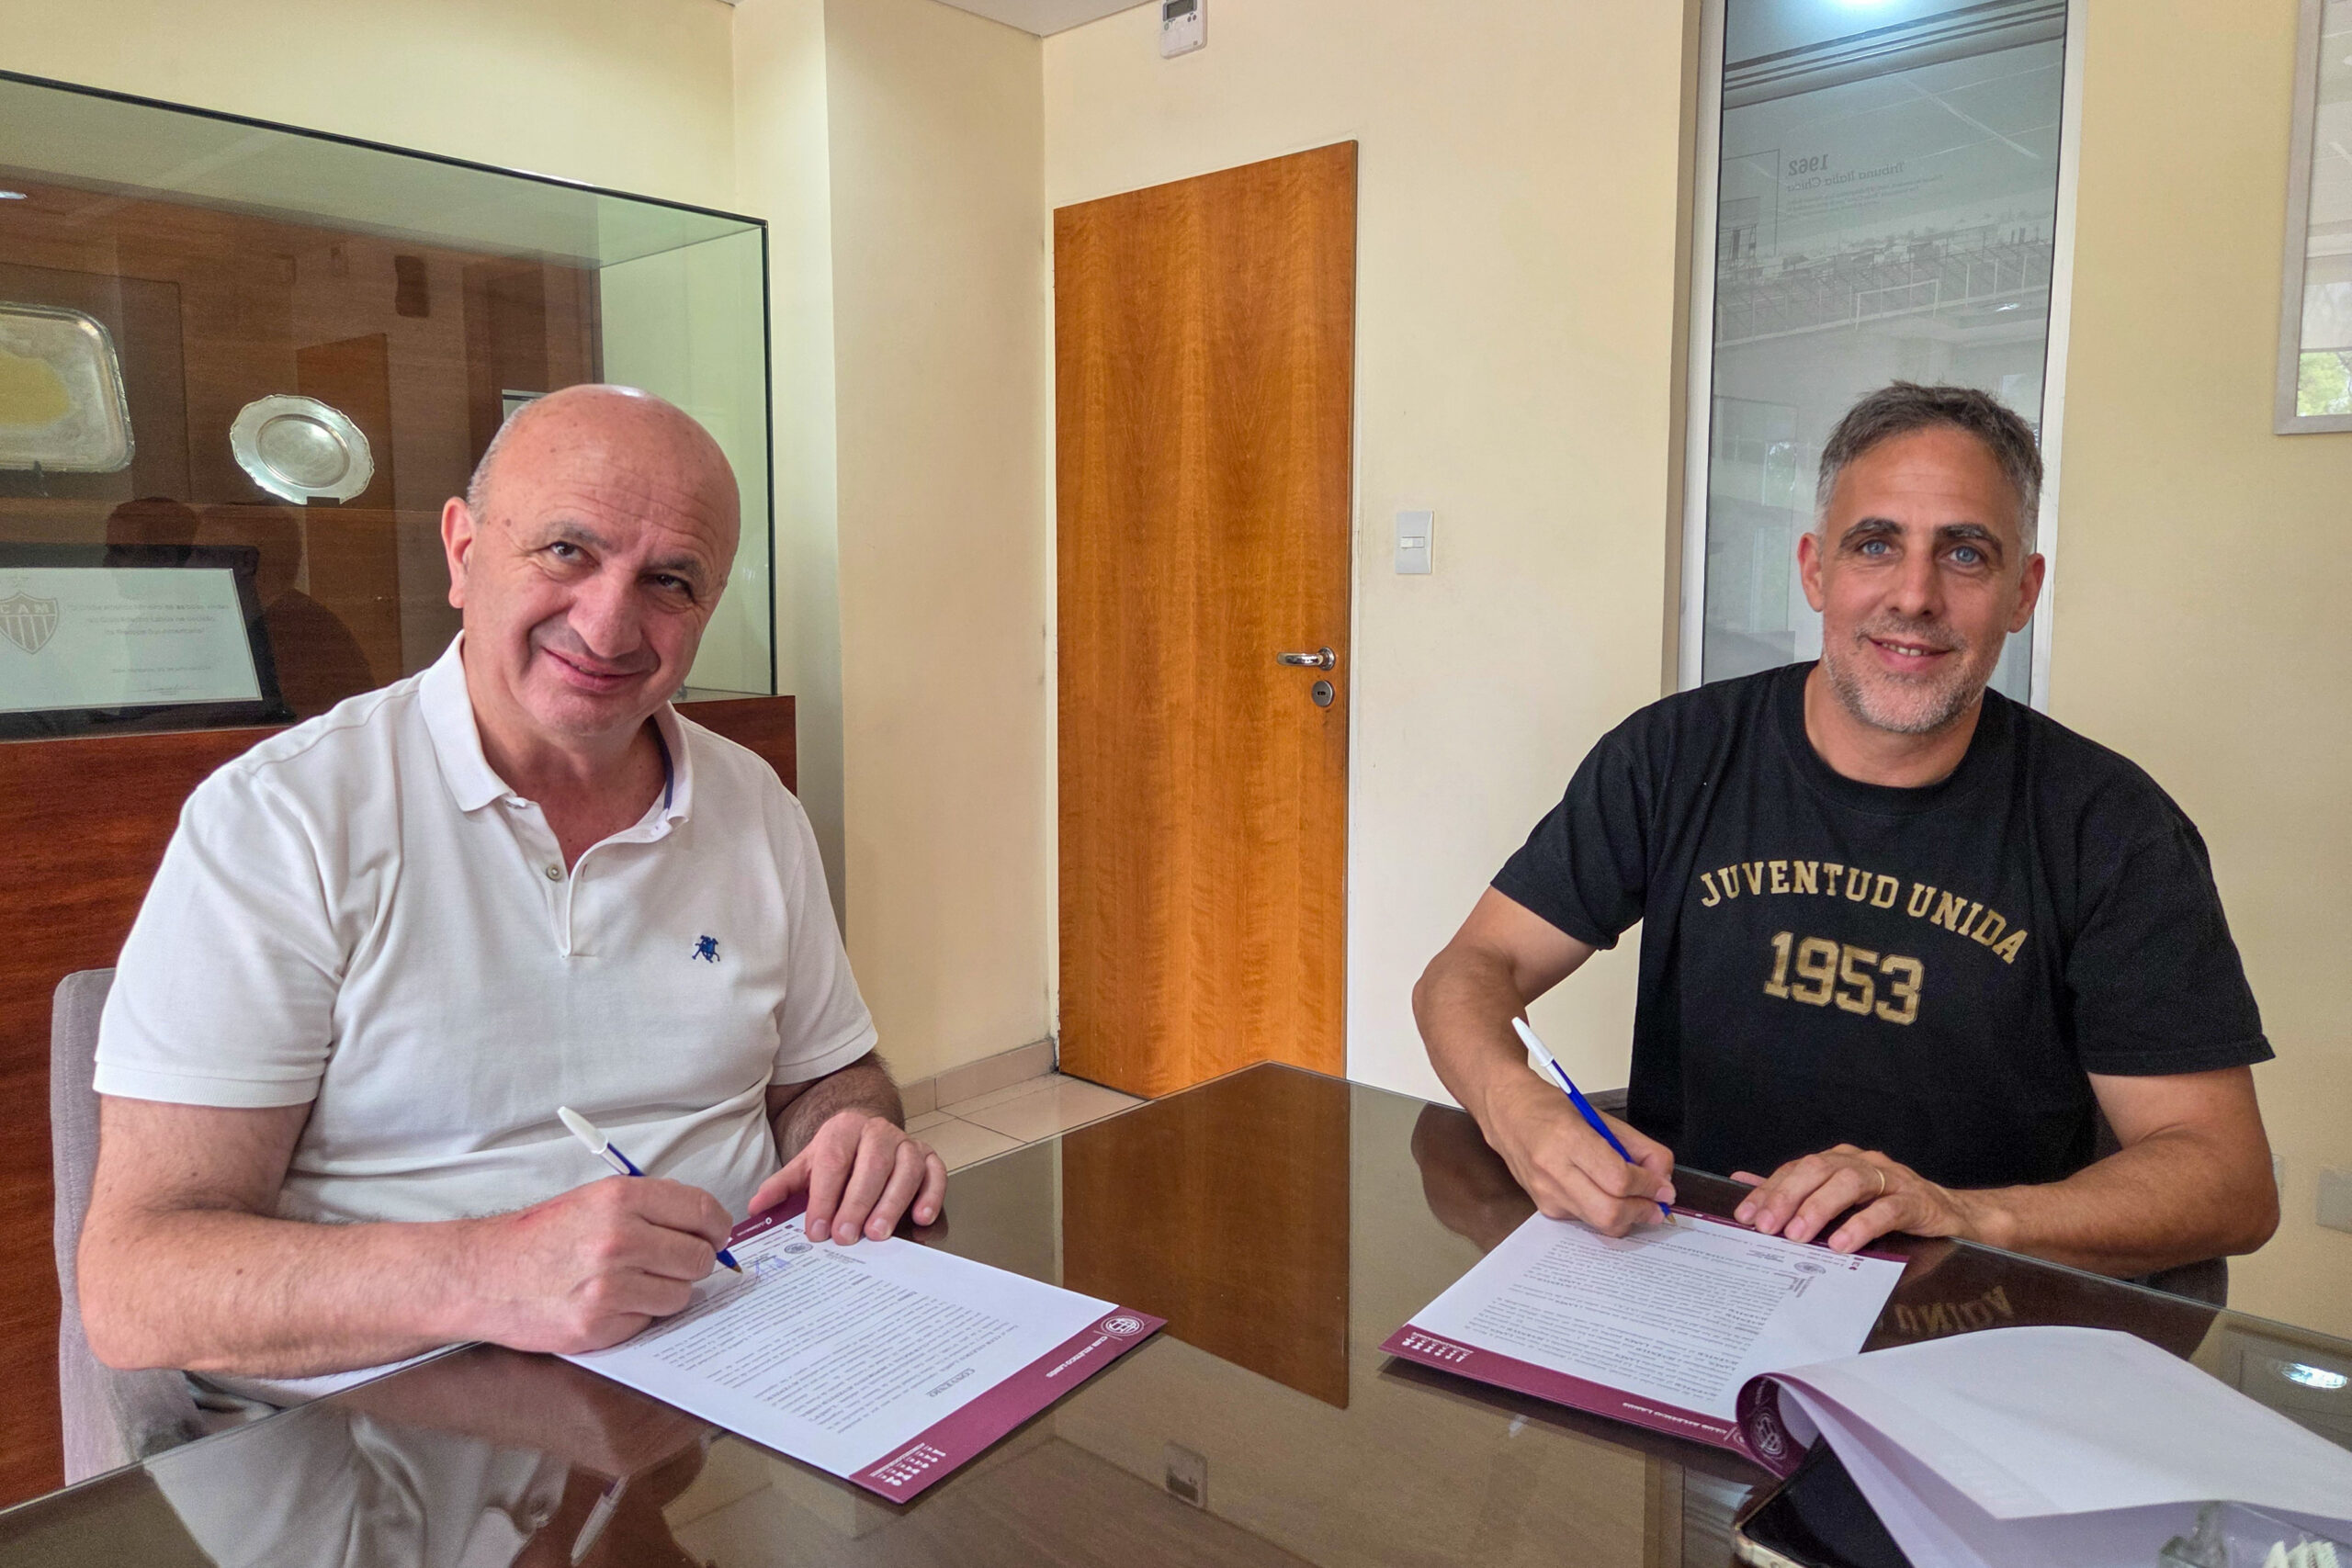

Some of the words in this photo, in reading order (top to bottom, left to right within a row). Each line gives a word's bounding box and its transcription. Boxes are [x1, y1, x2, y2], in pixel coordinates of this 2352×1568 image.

[1700, 859, 1899, 909] JUVENTUD
[1906, 882, 2029, 964] UNIDA
[1763, 930, 1926, 1026] 1953
